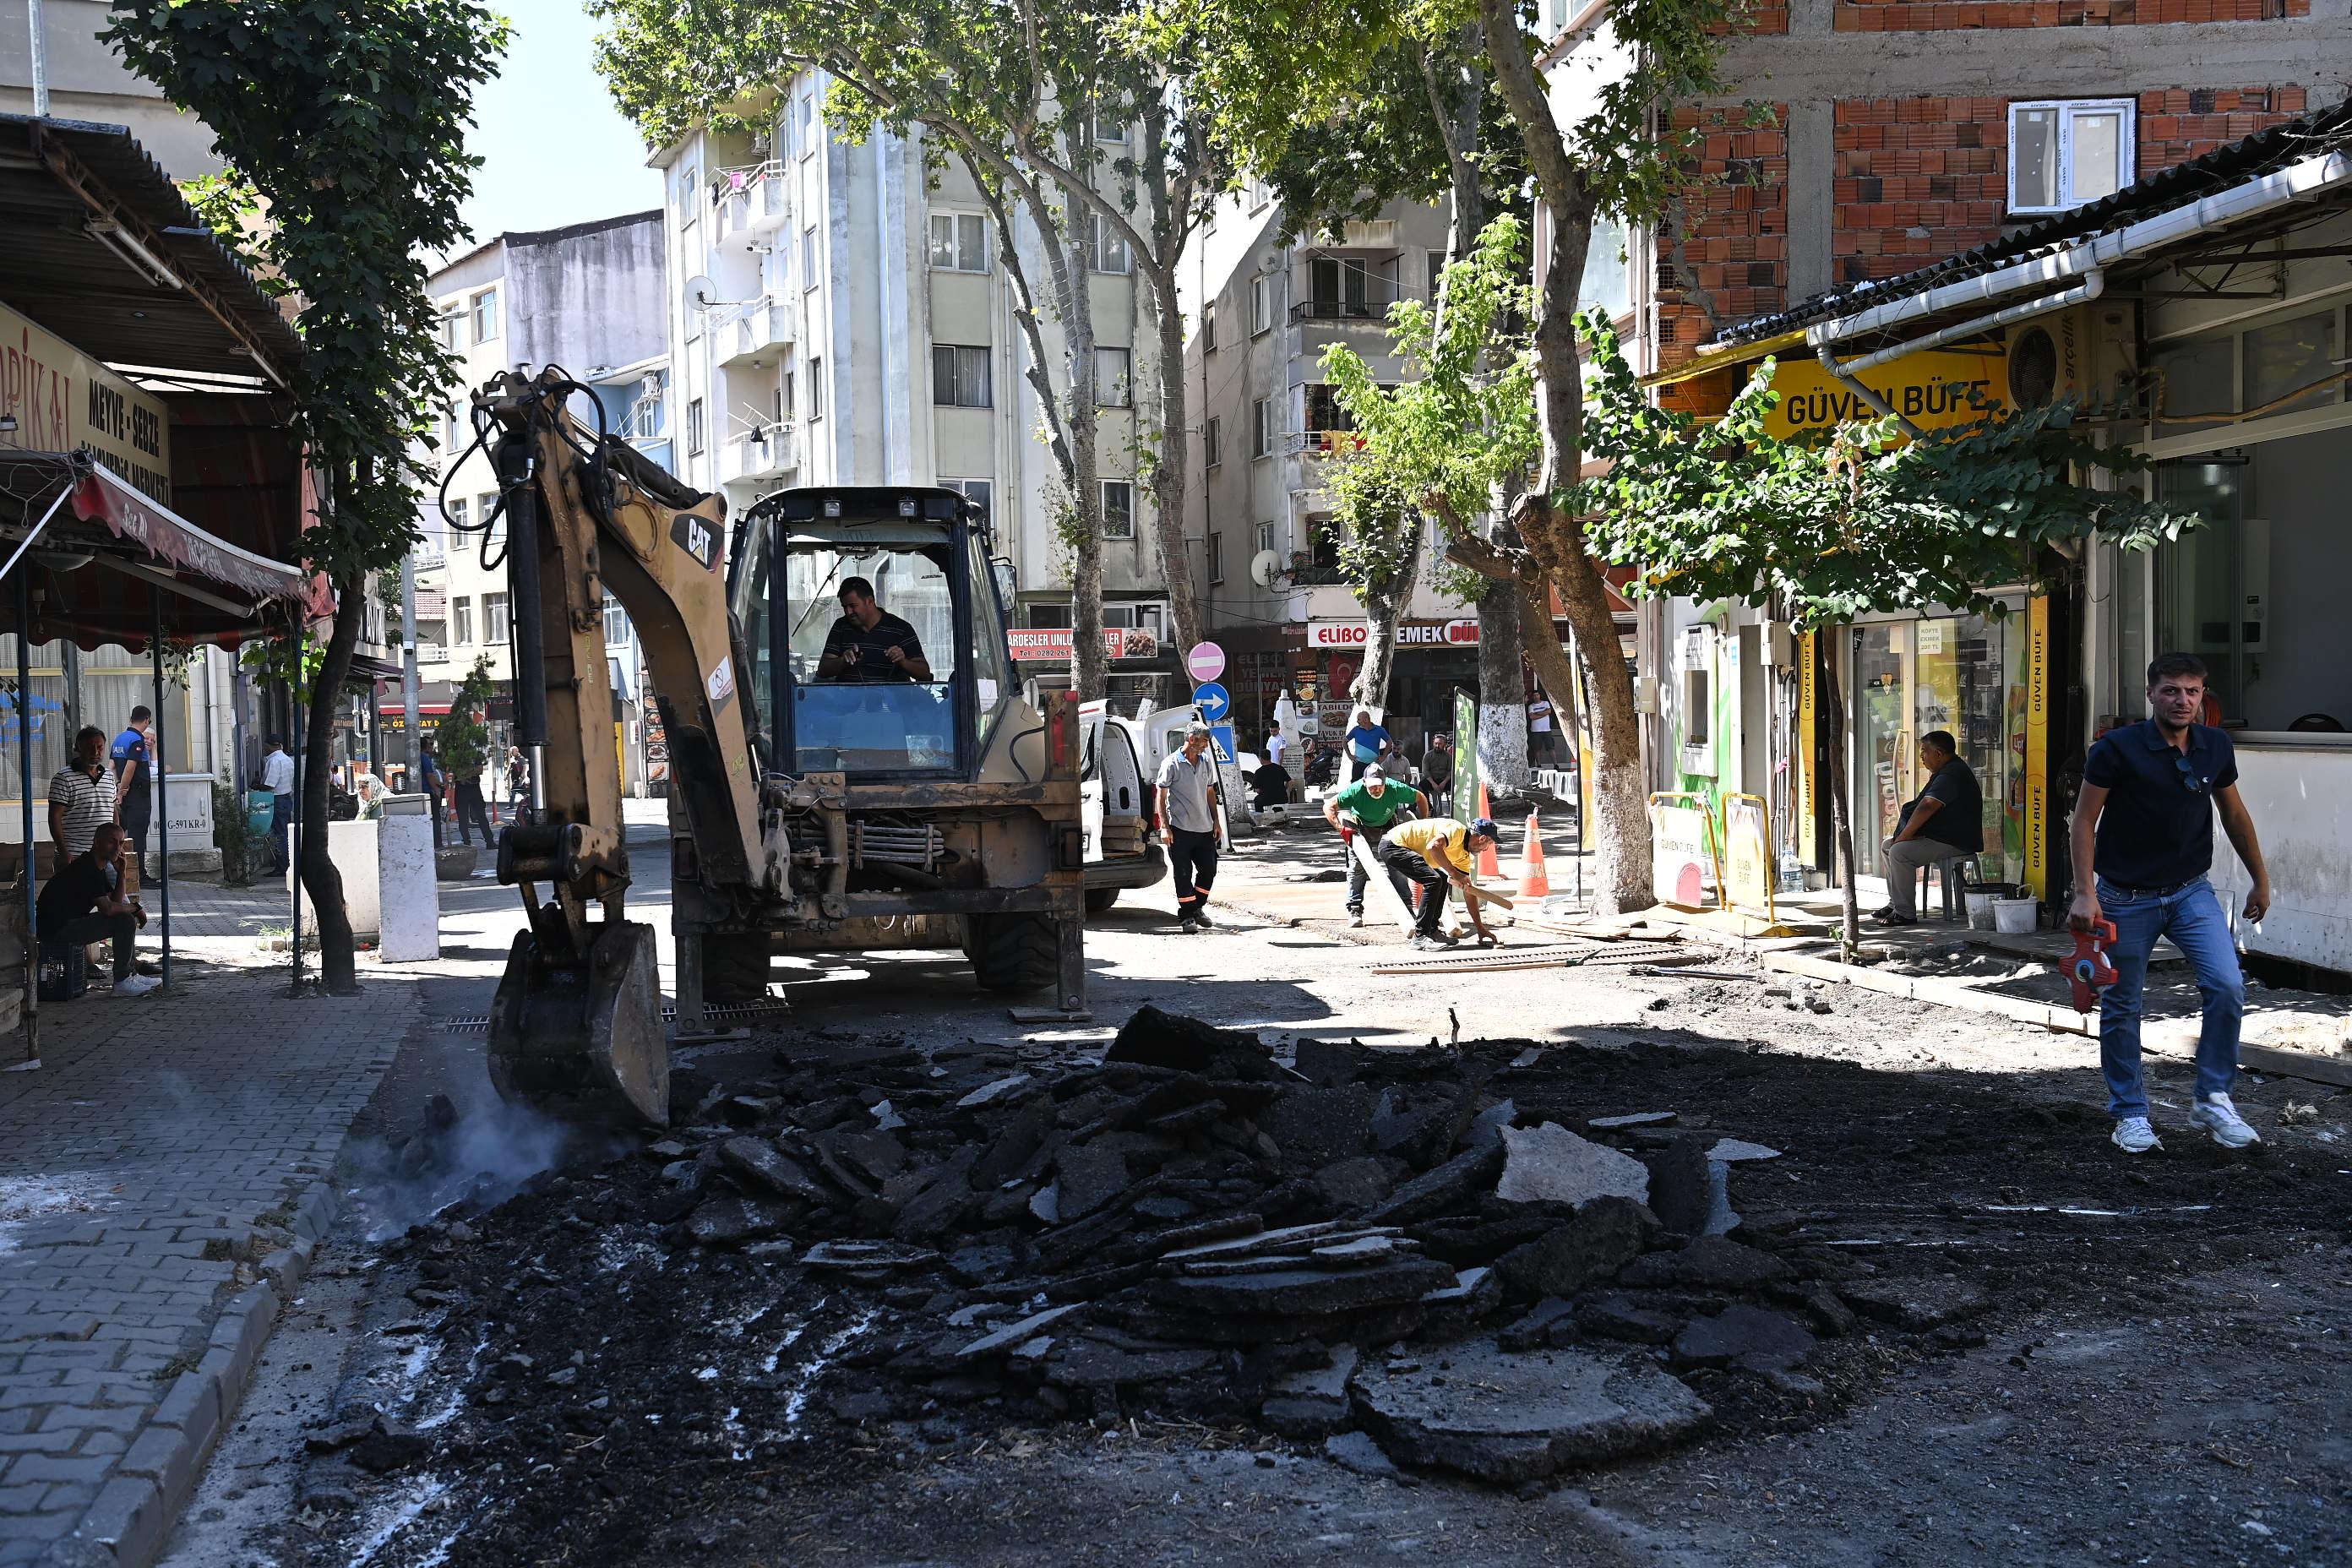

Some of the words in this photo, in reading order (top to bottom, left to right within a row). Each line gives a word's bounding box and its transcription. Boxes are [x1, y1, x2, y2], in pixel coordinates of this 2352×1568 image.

[2061, 313, 2075, 379] arçelik
[89, 378, 124, 441] MEYVE
[133, 403, 160, 458] SEBZE
[1788, 386, 1894, 425] GÜVEN
[1904, 376, 1991, 416] BÜFE
[688, 518, 711, 565] CAT
